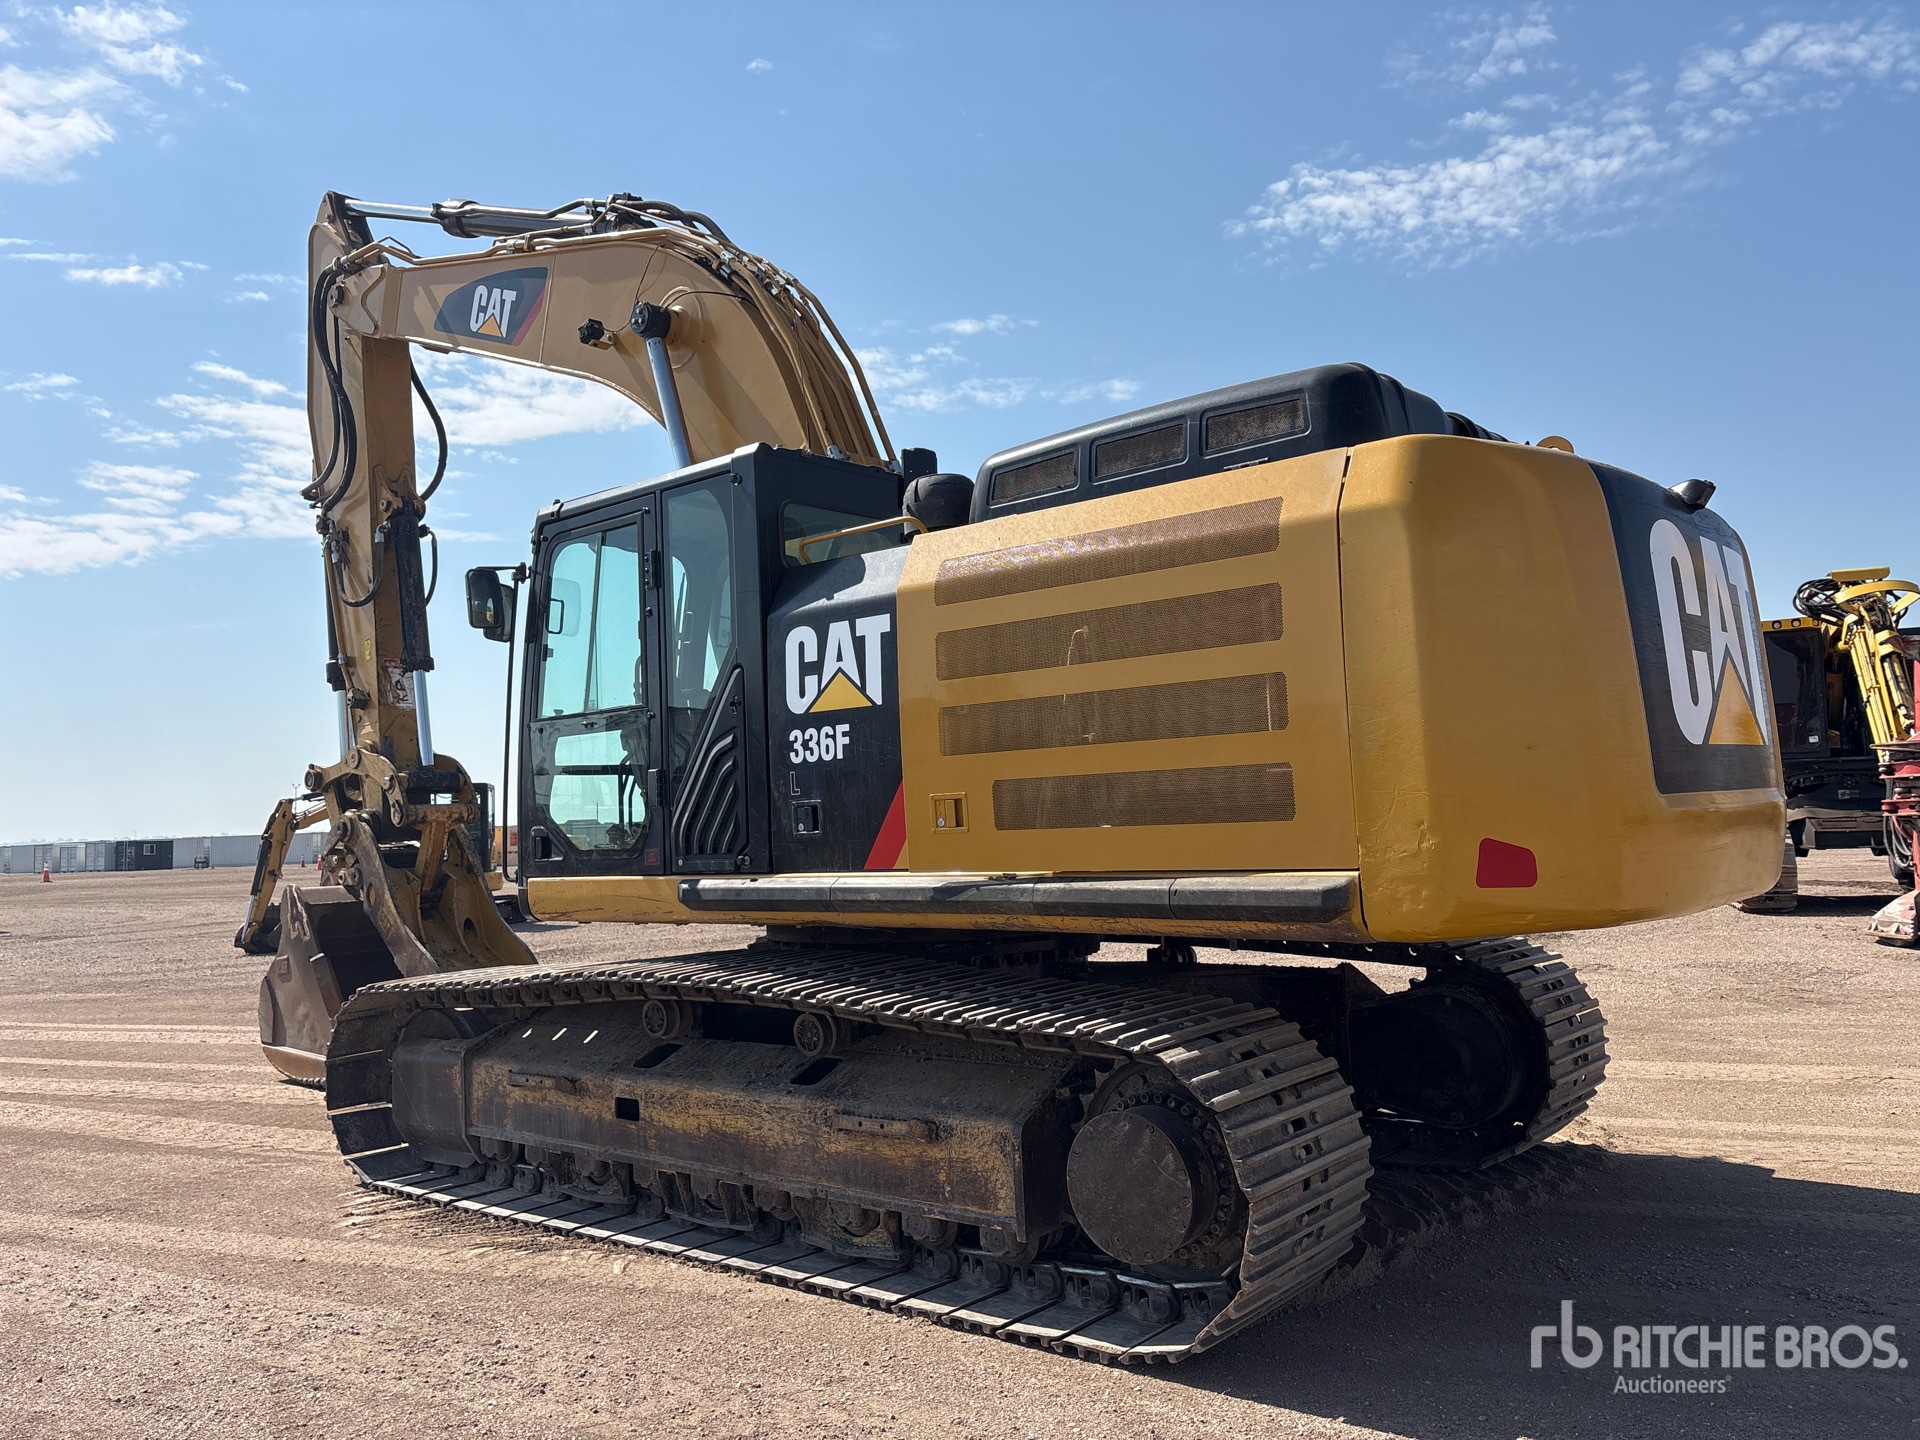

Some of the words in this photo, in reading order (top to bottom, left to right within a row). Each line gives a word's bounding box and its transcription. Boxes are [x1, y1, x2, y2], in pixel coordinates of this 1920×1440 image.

[470, 285, 517, 338] CAT
[1649, 518, 1770, 746] CAT
[785, 613, 891, 715] CAT
[788, 723, 850, 764] 336F
[789, 771, 801, 796] L
